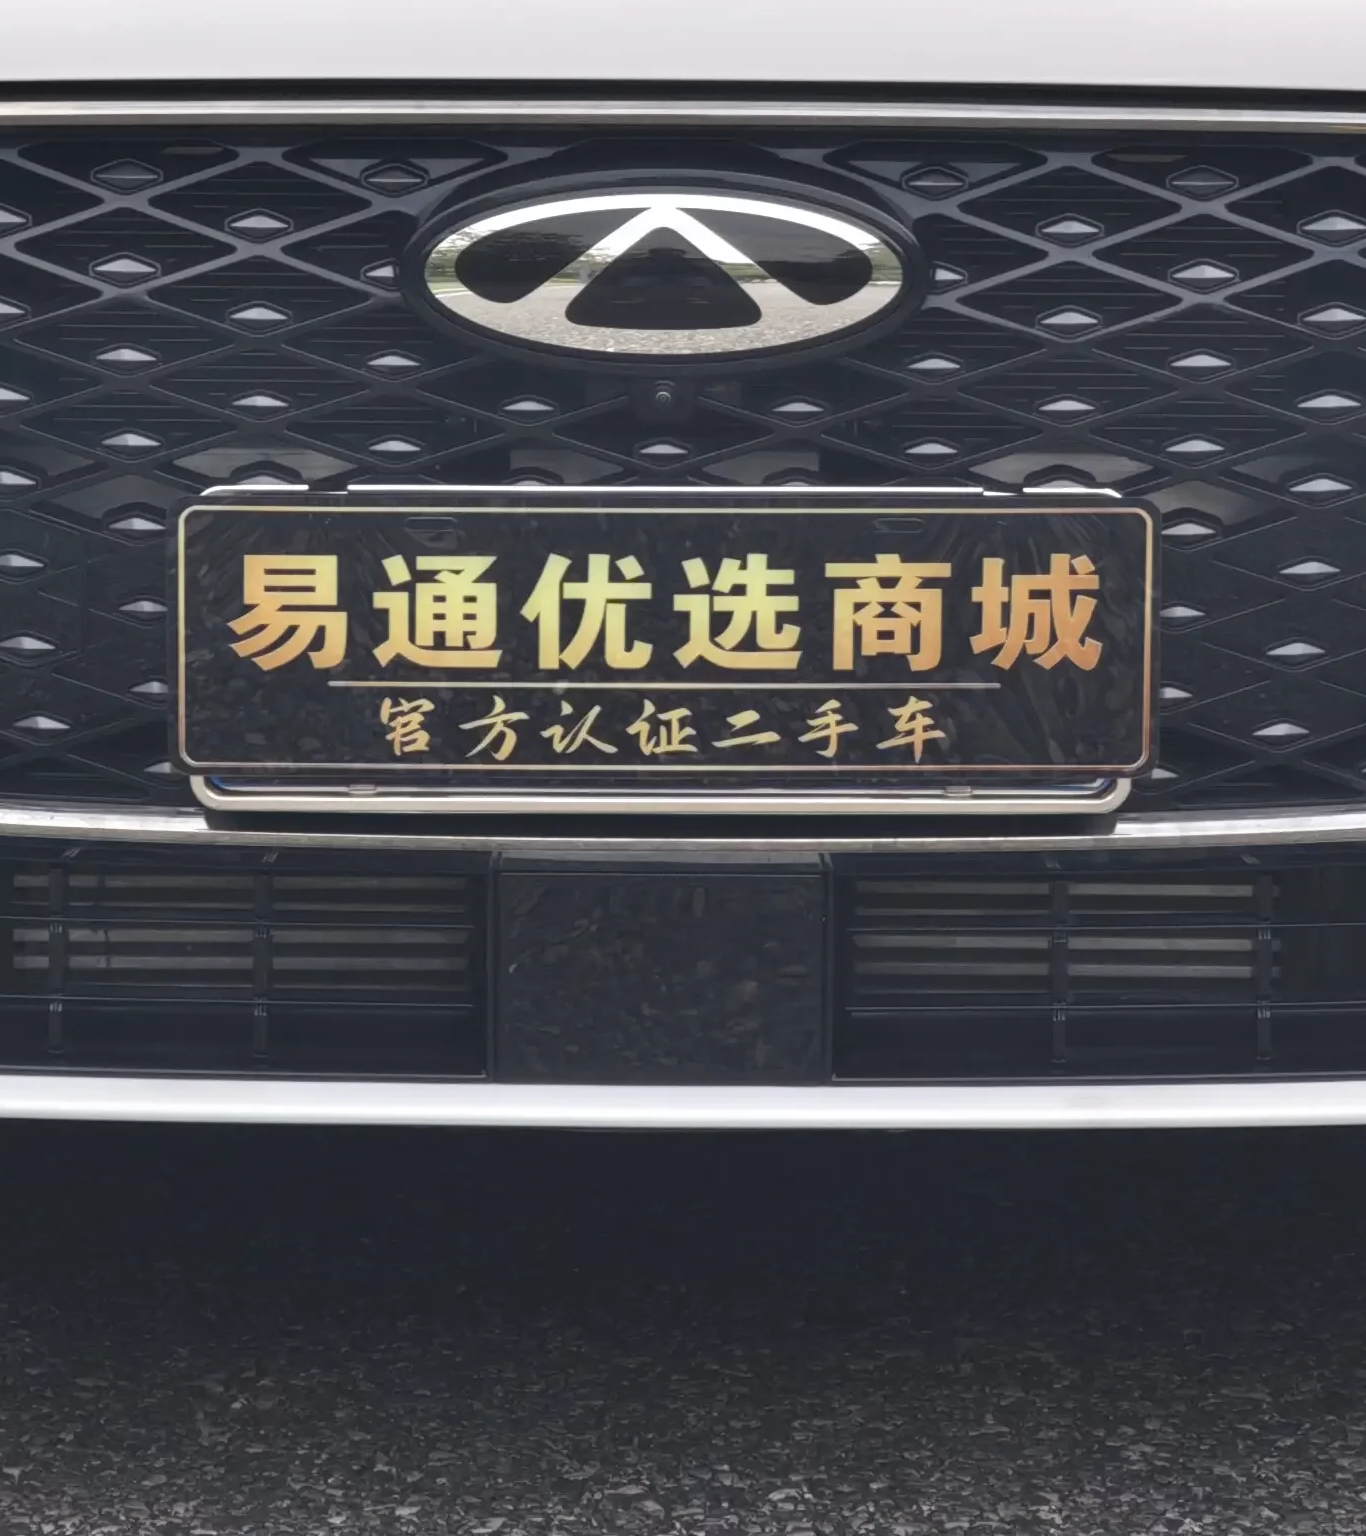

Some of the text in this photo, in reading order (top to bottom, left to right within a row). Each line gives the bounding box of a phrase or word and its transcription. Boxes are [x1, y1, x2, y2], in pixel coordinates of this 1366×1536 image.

[229, 552, 1103, 672] 易通优选商城
[378, 694, 948, 764] 官方认证二手车
